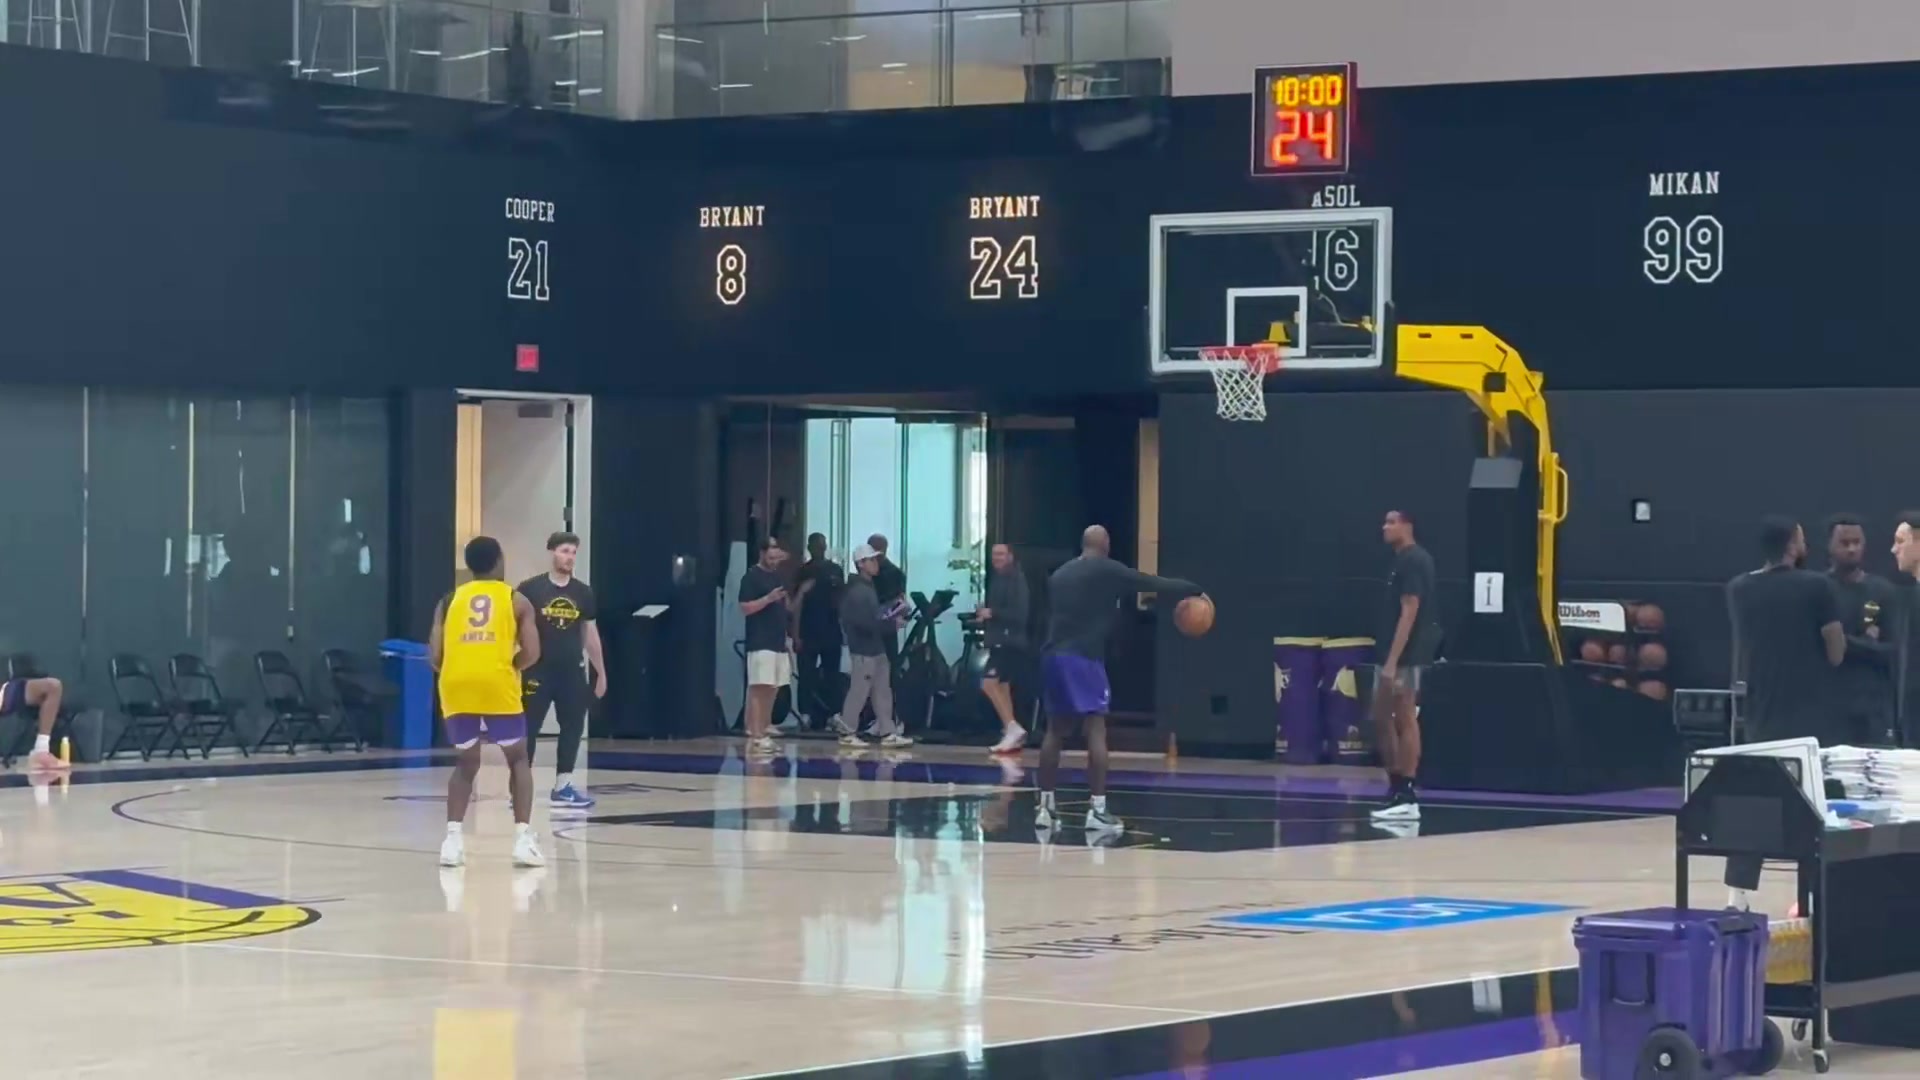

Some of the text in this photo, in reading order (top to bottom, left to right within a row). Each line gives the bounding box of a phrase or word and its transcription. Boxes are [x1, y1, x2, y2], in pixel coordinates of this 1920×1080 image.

[1273, 75, 1342, 106] 10:00
[1271, 110, 1334, 166] 24
[1311, 184, 1361, 208] ASOL
[1648, 171, 1720, 196] MIKAN
[505, 198, 555, 222] COOPER
[699, 205, 765, 228] BRYANT
[969, 195, 1040, 219] BRYANT
[1643, 215, 1723, 284] 99
[507, 237, 550, 301] 21
[716, 244, 746, 305] 8
[970, 235, 1038, 299] 24
[468, 594, 491, 628] 9
[1558, 605, 1600, 618] Wilson
